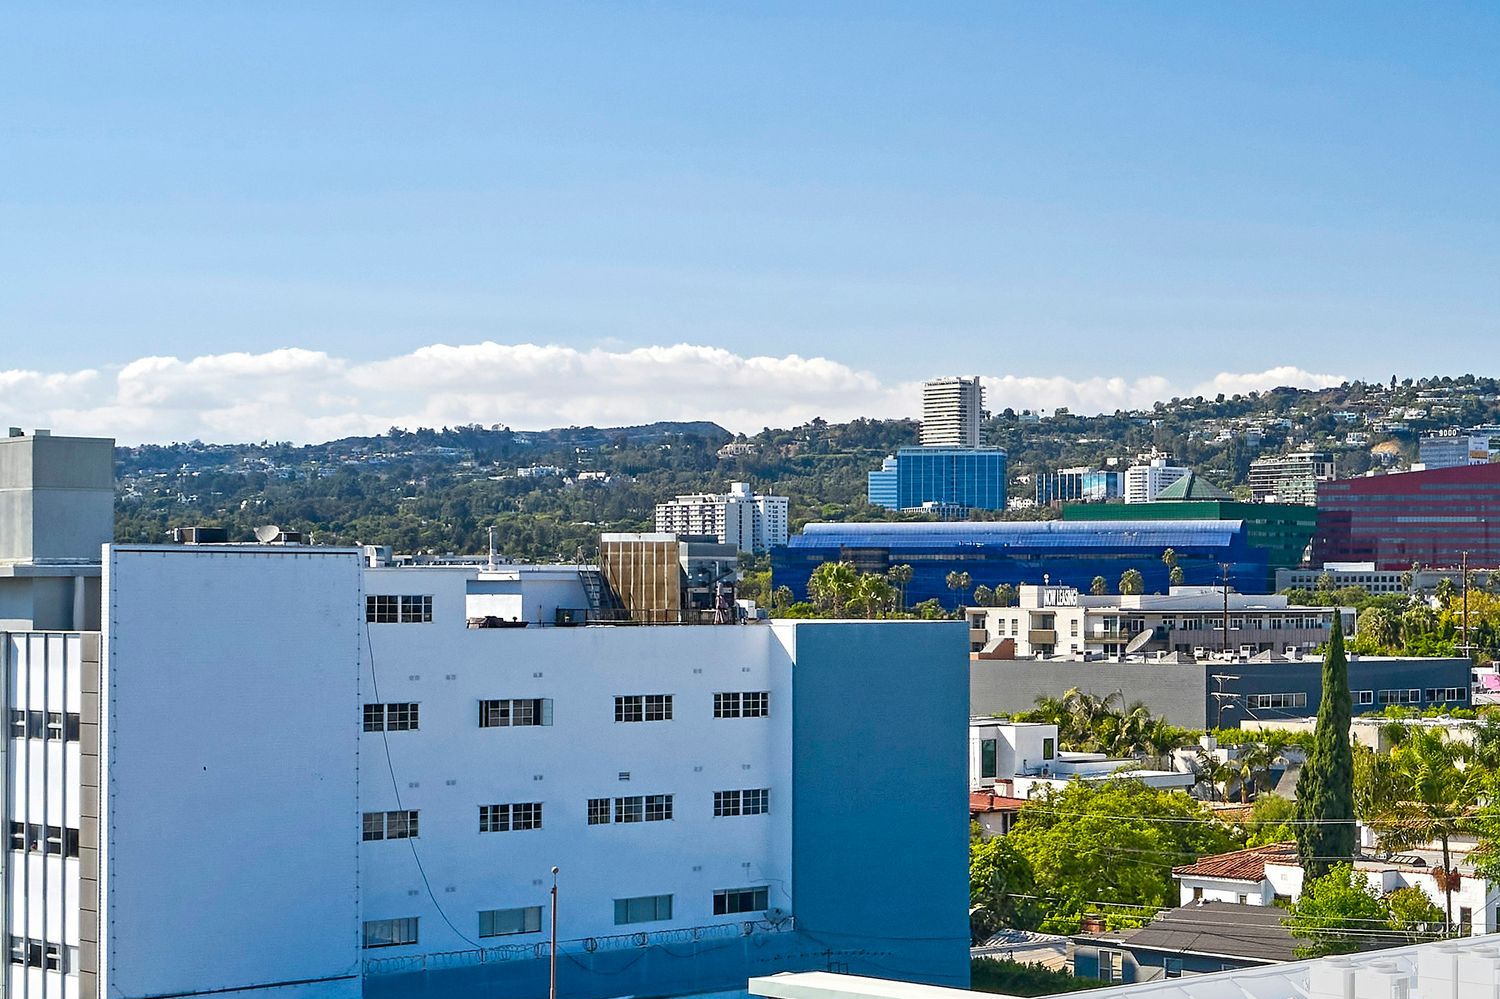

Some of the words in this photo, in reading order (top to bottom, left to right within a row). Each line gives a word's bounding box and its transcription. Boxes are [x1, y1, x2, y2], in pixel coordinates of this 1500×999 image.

[1439, 429, 1457, 437] 9000
[1044, 588, 1056, 606] NOW
[1057, 588, 1077, 606] LEASING
